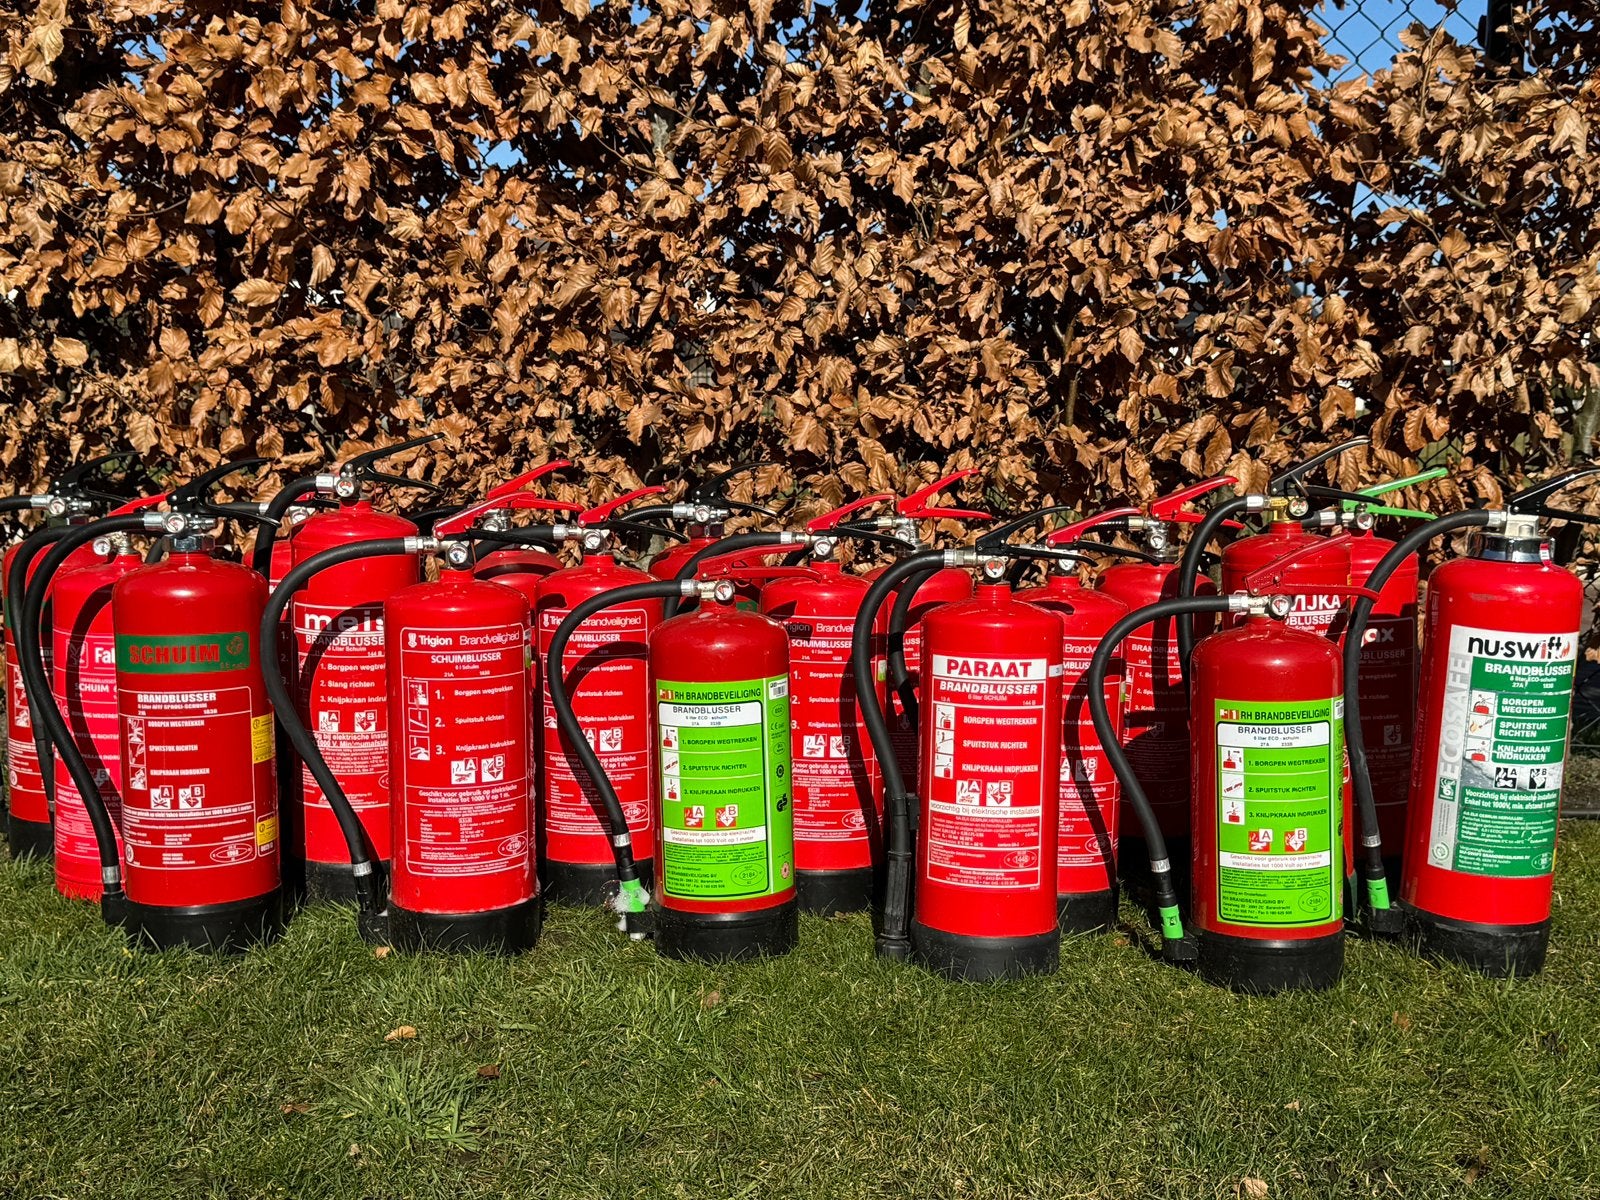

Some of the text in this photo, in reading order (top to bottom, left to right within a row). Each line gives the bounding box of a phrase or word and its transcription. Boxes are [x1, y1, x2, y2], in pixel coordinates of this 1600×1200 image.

[304, 610, 384, 632] meis
[784, 621, 810, 632] rigion
[306, 635, 384, 646] BRANDBLUSSE
[418, 630, 520, 648] Trigion Brandveiligheid
[129, 644, 221, 664] SCHUIM
[1132, 644, 1178, 654] BRANDBLUS
[94, 647, 116, 664] Fal
[431, 652, 501, 664] SCHUIMBLUSSER
[327, 664, 358, 672] Borgpen
[360, 664, 386, 672] wegtre
[947, 658, 1032, 678] PARAAT
[1485, 662, 1572, 676] BRANDBLUSSER
[793, 670, 801, 680] 1.
[75, 682, 110, 693] SCHUIM
[328, 680, 348, 689] Slang
[940, 680, 1037, 696] BRANDBLUSSER
[137, 692, 217, 703] BRANDBLUSSER
[434, 685, 514, 700] 1. Borgpen wegtrekken
[577, 690, 602, 698] Spuitstuk
[674, 688, 761, 701] RH BRANDBEVEILIGING
[327, 696, 366, 704] Knijpkraan
[792, 695, 800, 704] 2.
[1502, 698, 1544, 706] BORGPEN
[672, 706, 741, 715] BRANDBLUSSER
[1240, 708, 1330, 720] RH BRANDBEVEILIGING
[1502, 706, 1557, 715] WEGTREKKEN
[367, 712, 374, 720] B
[435, 714, 505, 728] 2. Spuitstuk richten
[964, 716, 1037, 725] BORGPEN WEGTREKKEN
[1442, 656, 1470, 778] ECOSAFE
[791, 720, 800, 729] 3.
[1500, 721, 1548, 731] SPUITSTUK
[587, 729, 594, 739] A
[614, 728, 622, 738] B
[1238, 726, 1313, 735] BRANDBLUSSER
[1498, 730, 1537, 738] RICHTEN
[717, 736, 757, 745] WEGTREKKEN
[816, 735, 826, 745] A
[844, 736, 851, 744] B
[963, 740, 1028, 749] SPUITSTUK RICHTEN
[435, 740, 516, 755] 3. Knijpkraan indrukken
[1497, 744, 1550, 753] KNIJPKRAAN
[495, 756, 504, 766] B
[1496, 752, 1546, 760] INDRUKKEN
[466, 760, 476, 770] A
[1090, 760, 1096, 768] B
[1288, 758, 1325, 766] WEGTREKKEN
[962, 764, 1003, 773] KNIJPKRAAN
[162, 787, 170, 797] A
[194, 786, 201, 796] B
[728, 786, 760, 794] INDRUKKEN
[969, 782, 980, 792] A
[1001, 782, 1010, 792] B
[418, 790, 442, 798] Geschikt
[458, 790, 481, 798] gebruik
[1465, 789, 1498, 800] Voorzichtig
[1500, 792, 1508, 802] bij
[428, 796, 459, 804] installaties
[1465, 798, 1481, 806] Enkel
[1493, 801, 1511, 810] 1000V,
[694, 807, 703, 816] A
[728, 806, 736, 815] B
[931, 802, 1008, 816] voorzichtig bij elektrische
[1297, 809, 1327, 817] INDRUKKEN
[1262, 830, 1270, 840] A
[1298, 830, 1305, 839] B
[1268, 855, 1288, 863] gebruik
